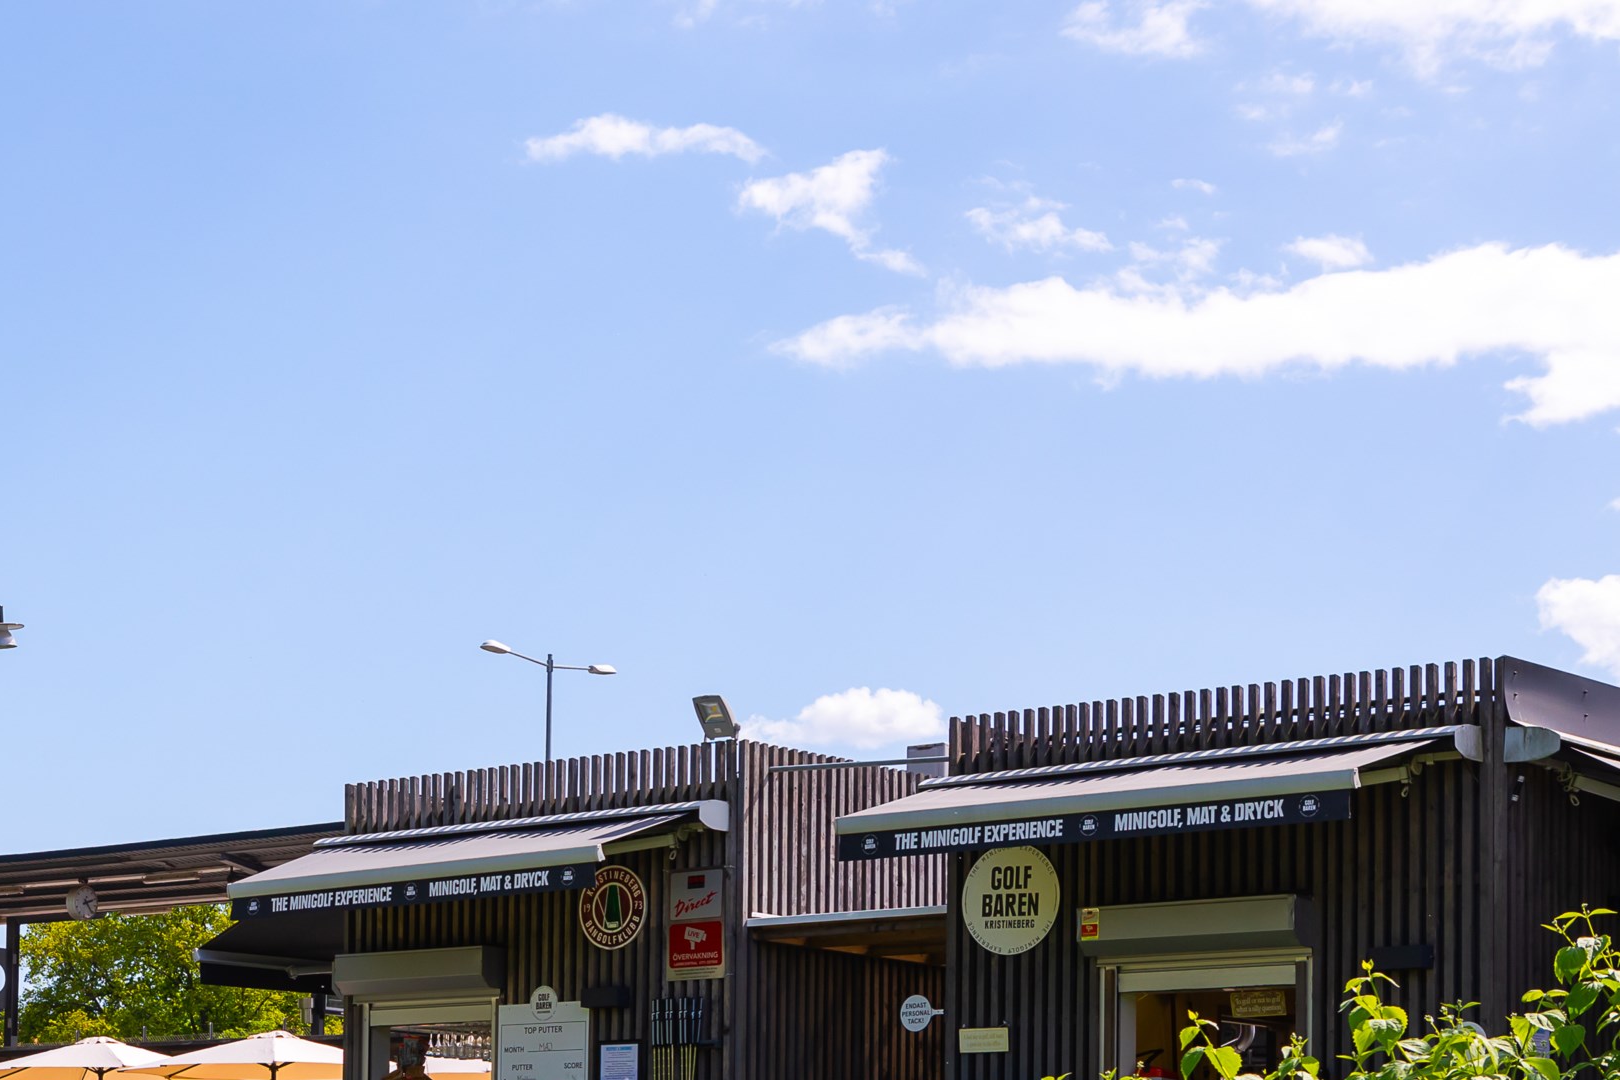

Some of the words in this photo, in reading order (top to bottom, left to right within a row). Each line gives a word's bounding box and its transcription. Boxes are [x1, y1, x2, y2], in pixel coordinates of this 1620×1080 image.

[1114, 809, 1184, 832] MINIGOLF,
[1186, 805, 1218, 826] MAT
[1220, 804, 1231, 823] &
[1234, 799, 1284, 822] DRYCK
[894, 833, 918, 850] THE
[920, 826, 981, 849] MINIGOLF
[984, 819, 1064, 843] EXPERIENCE
[991, 865, 1033, 891] GOLF
[429, 878, 478, 897] MINIGOLF,
[480, 875, 501, 892] MAT
[504, 874, 512, 890] &
[514, 871, 550, 889] DRYCK
[271, 897, 288, 912] THE
[289, 892, 334, 911] MINIGOLF
[334, 886, 393, 906] EXPERIENCE
[674, 890, 718, 918] Direct
[583, 904, 591, 913] 19
[634, 900, 643, 910] 73
[981, 892, 1040, 918] BAREN
[984, 919, 1036, 930] KRISTINEBERG
[585, 915, 640, 945] BANGOLFKLUBB
[687, 930, 700, 939] LIVE
[672, 951, 719, 961] ÖVERVAKNING
[538, 993, 550, 1001] GOLF
[535, 1002, 552, 1010] BAREN
[524, 1027, 537, 1035] TOP
[538, 1025, 563, 1034] PUTTER
[503, 1046, 525, 1054] MONTH
[563, 1062, 583, 1070] SCORE
